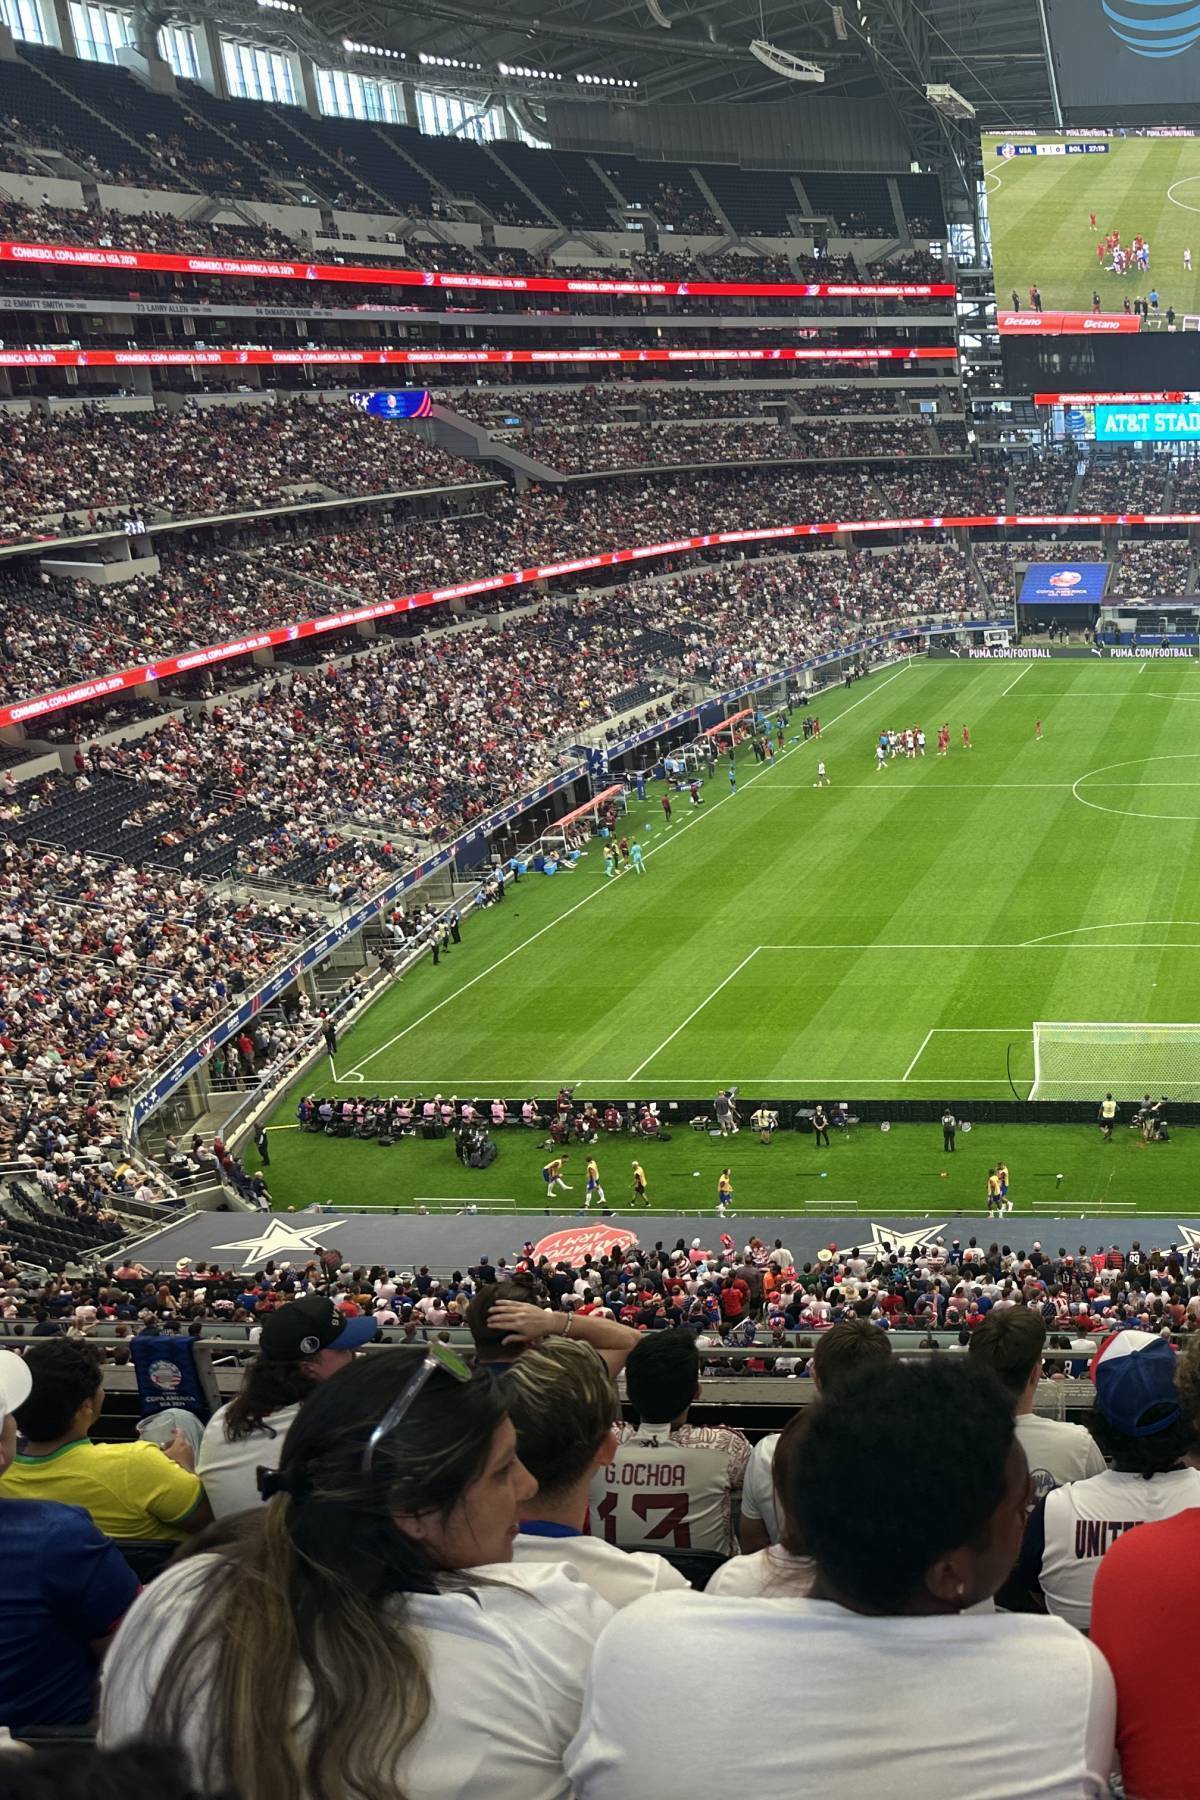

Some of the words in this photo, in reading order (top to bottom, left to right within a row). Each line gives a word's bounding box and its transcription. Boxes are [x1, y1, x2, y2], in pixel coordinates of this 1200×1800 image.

[12, 246, 53, 259] CONMEBOL
[54, 249, 74, 261] COPA
[75, 251, 105, 263] AMERICA
[106, 253, 120, 264] USA
[120, 254, 137, 265] 2024
[43, 300, 64, 309] SMITH
[1004, 317, 1041, 326] Betano
[1084, 319, 1120, 329] Betano
[1104, 413, 1148, 432] AT&T
[969, 648, 1051, 658] PUMA.COM/FOOTBALL
[1110, 648, 1193, 658] PUMA.COM/FOOTBALL
[604, 1463, 687, 1488] G.OCHOA
[1075, 1519, 1144, 1559] UNIT
